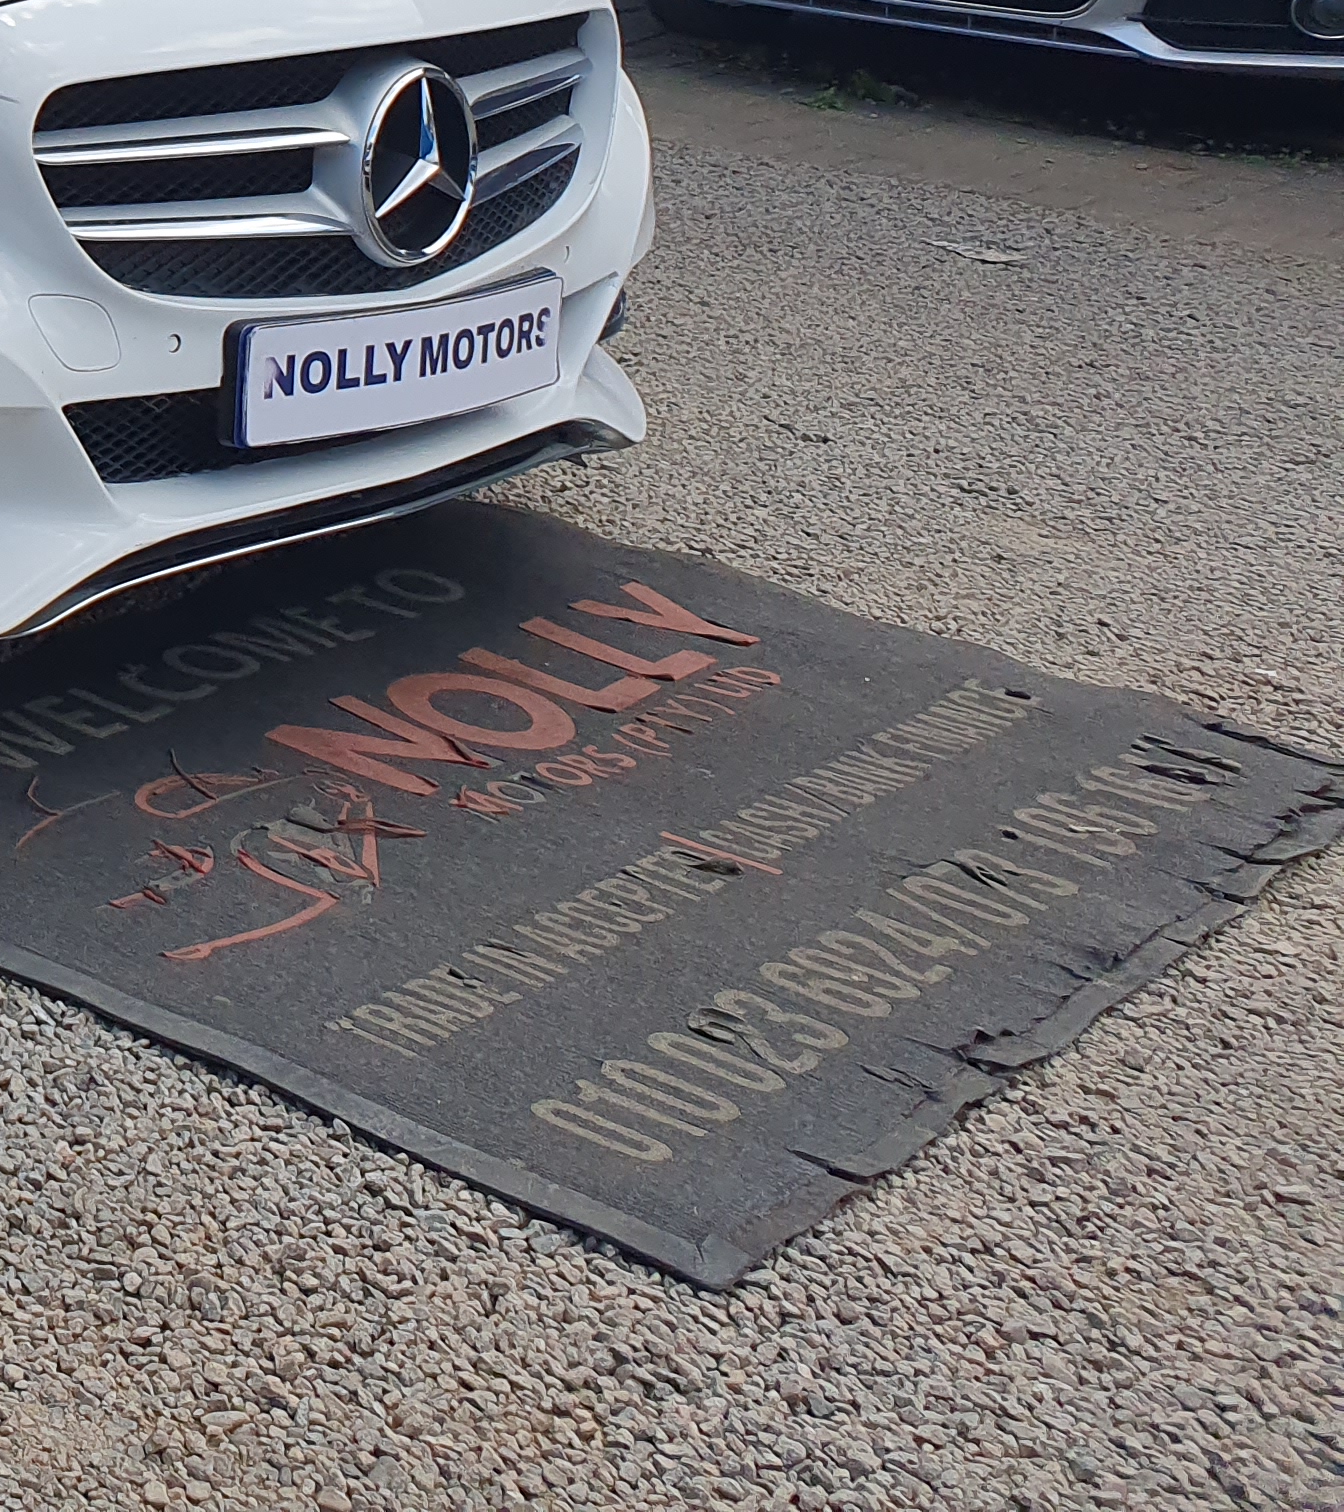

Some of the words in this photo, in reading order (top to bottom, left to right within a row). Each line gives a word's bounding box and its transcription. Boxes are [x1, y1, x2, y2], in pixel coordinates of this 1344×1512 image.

[263, 339, 412, 399] NOLLY
[419, 307, 551, 378] MOTORS
[328, 568, 465, 618] TO
[265, 580, 760, 796] NOLLY
[324, 963, 523, 1058] TRADE
[463, 939, 567, 987] IN
[530, 1060, 741, 1162] 010
[647, 988, 849, 1089] 023
